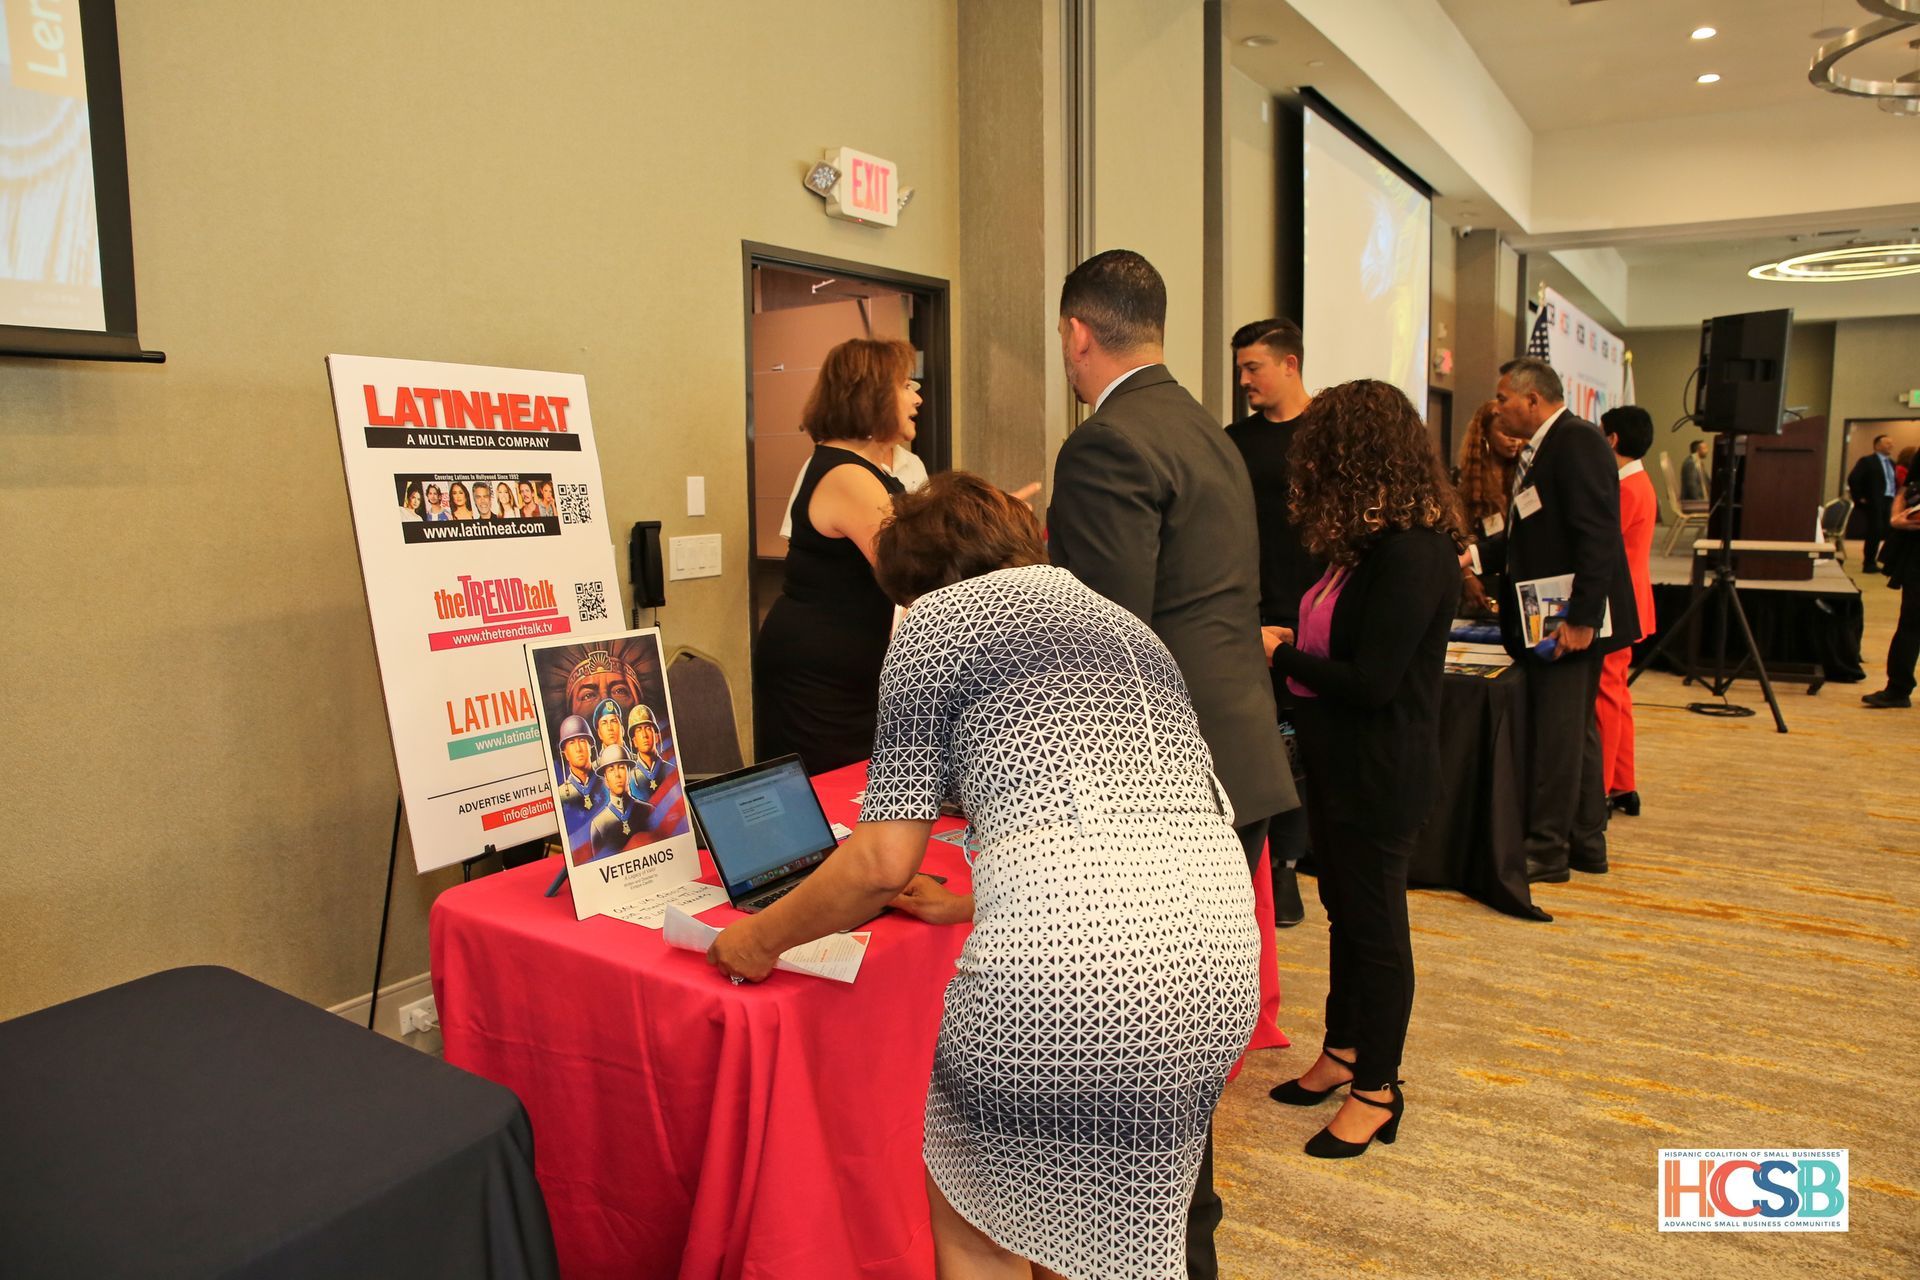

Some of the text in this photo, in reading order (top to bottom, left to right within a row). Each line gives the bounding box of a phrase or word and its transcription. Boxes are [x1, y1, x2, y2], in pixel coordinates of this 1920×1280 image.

[851, 157, 891, 215] EXIT
[363, 384, 570, 432] LATINHEAT
[406, 434, 550, 448] A MULTI-MEDIA COMPANY
[423, 521, 546, 539] www.latinheat.com
[453, 622, 553, 645] www.thetrendtalk.tv
[458, 781, 552, 815] ADVERTISE WITH LA
[503, 800, 554, 823] info@latinh
[599, 848, 674, 884] VETERANOS
